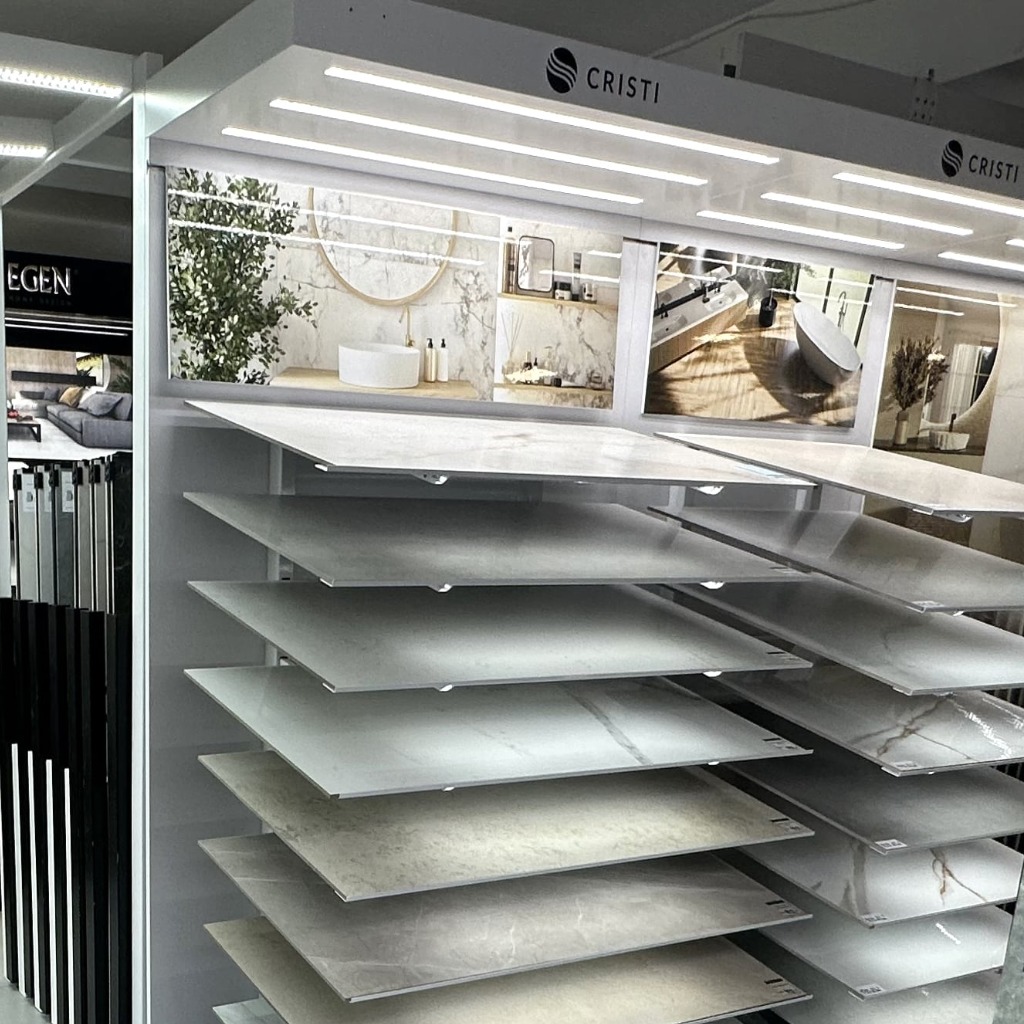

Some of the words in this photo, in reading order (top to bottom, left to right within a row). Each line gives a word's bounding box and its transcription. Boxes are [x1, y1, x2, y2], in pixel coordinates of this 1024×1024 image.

[587, 66, 659, 104] CRISTI
[968, 154, 1019, 184] CRISTI
[7, 262, 72, 296] EGEN
